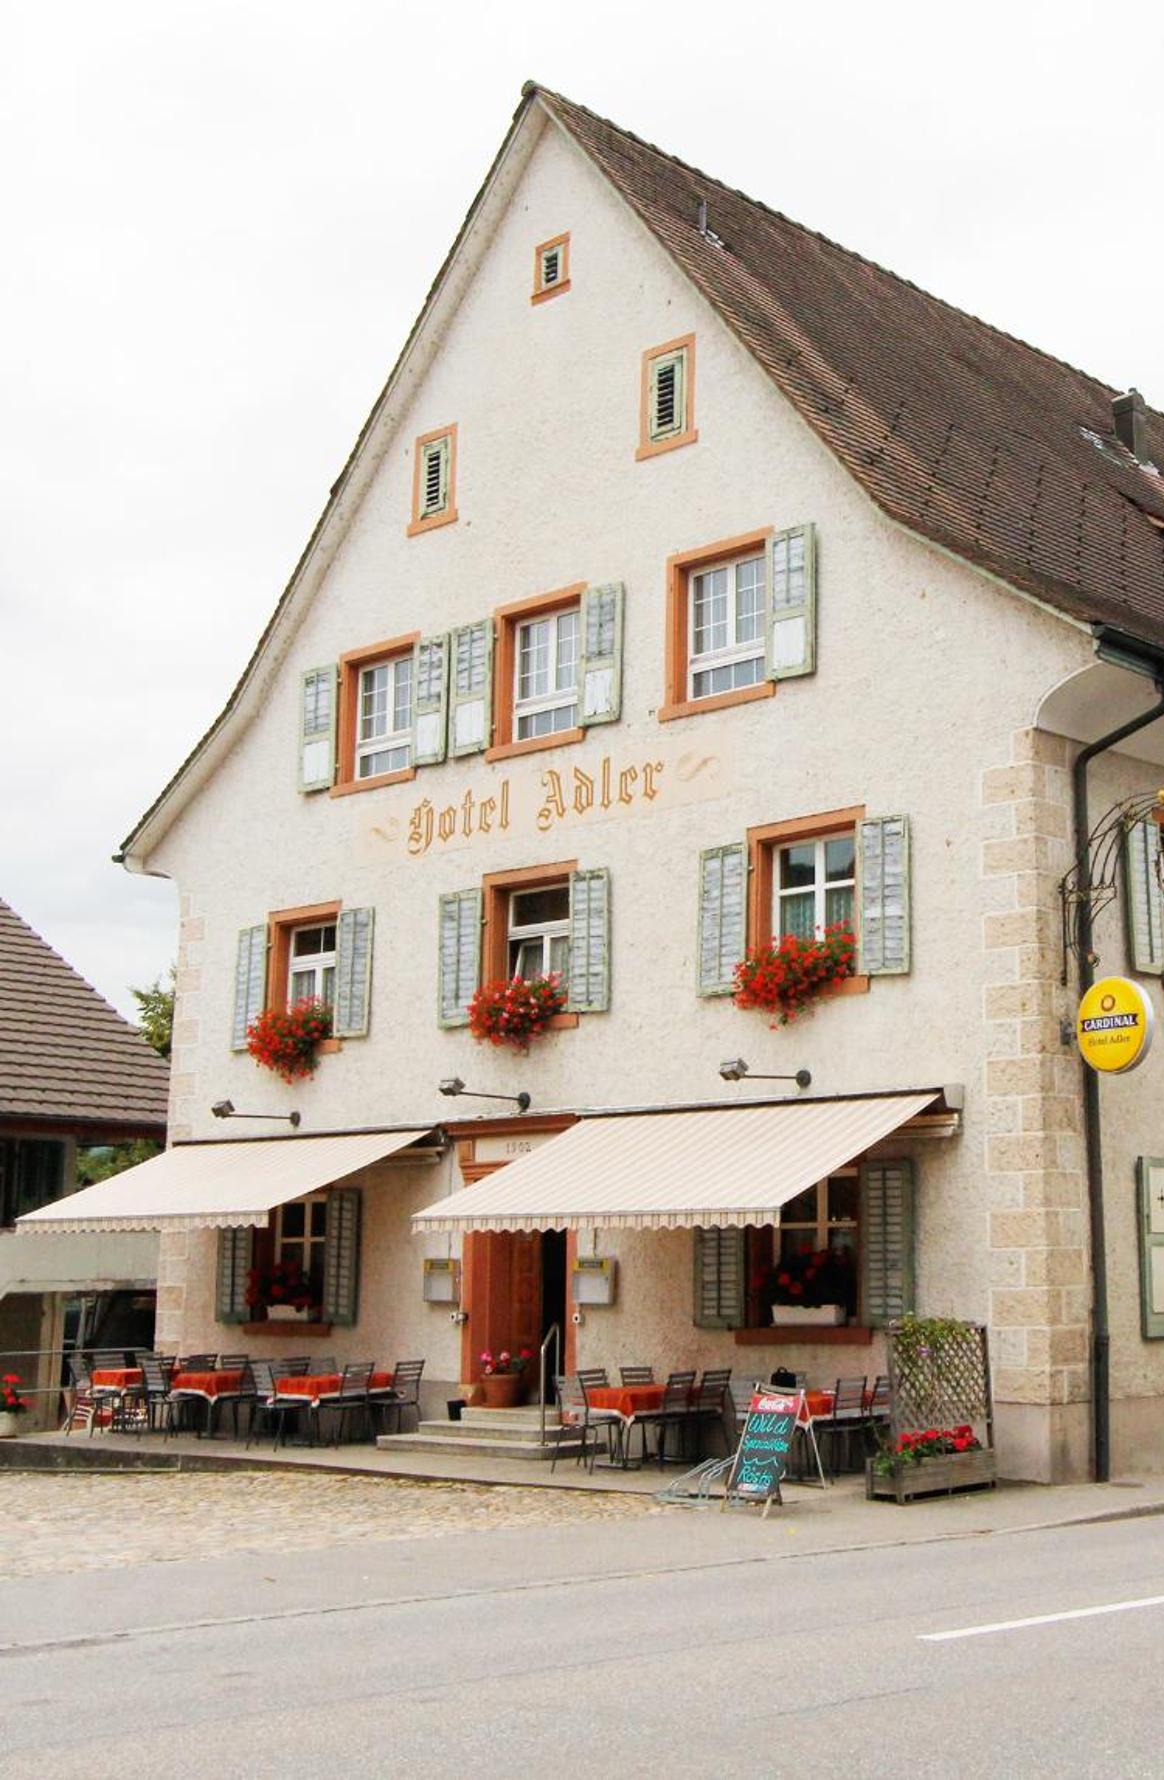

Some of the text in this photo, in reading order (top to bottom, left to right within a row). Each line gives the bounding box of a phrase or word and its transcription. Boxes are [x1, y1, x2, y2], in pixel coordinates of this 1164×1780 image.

[408, 757, 664, 854] Hotel Adler
[1084, 1014, 1135, 1031] CARDINAL
[748, 1414, 789, 1434] Wild
